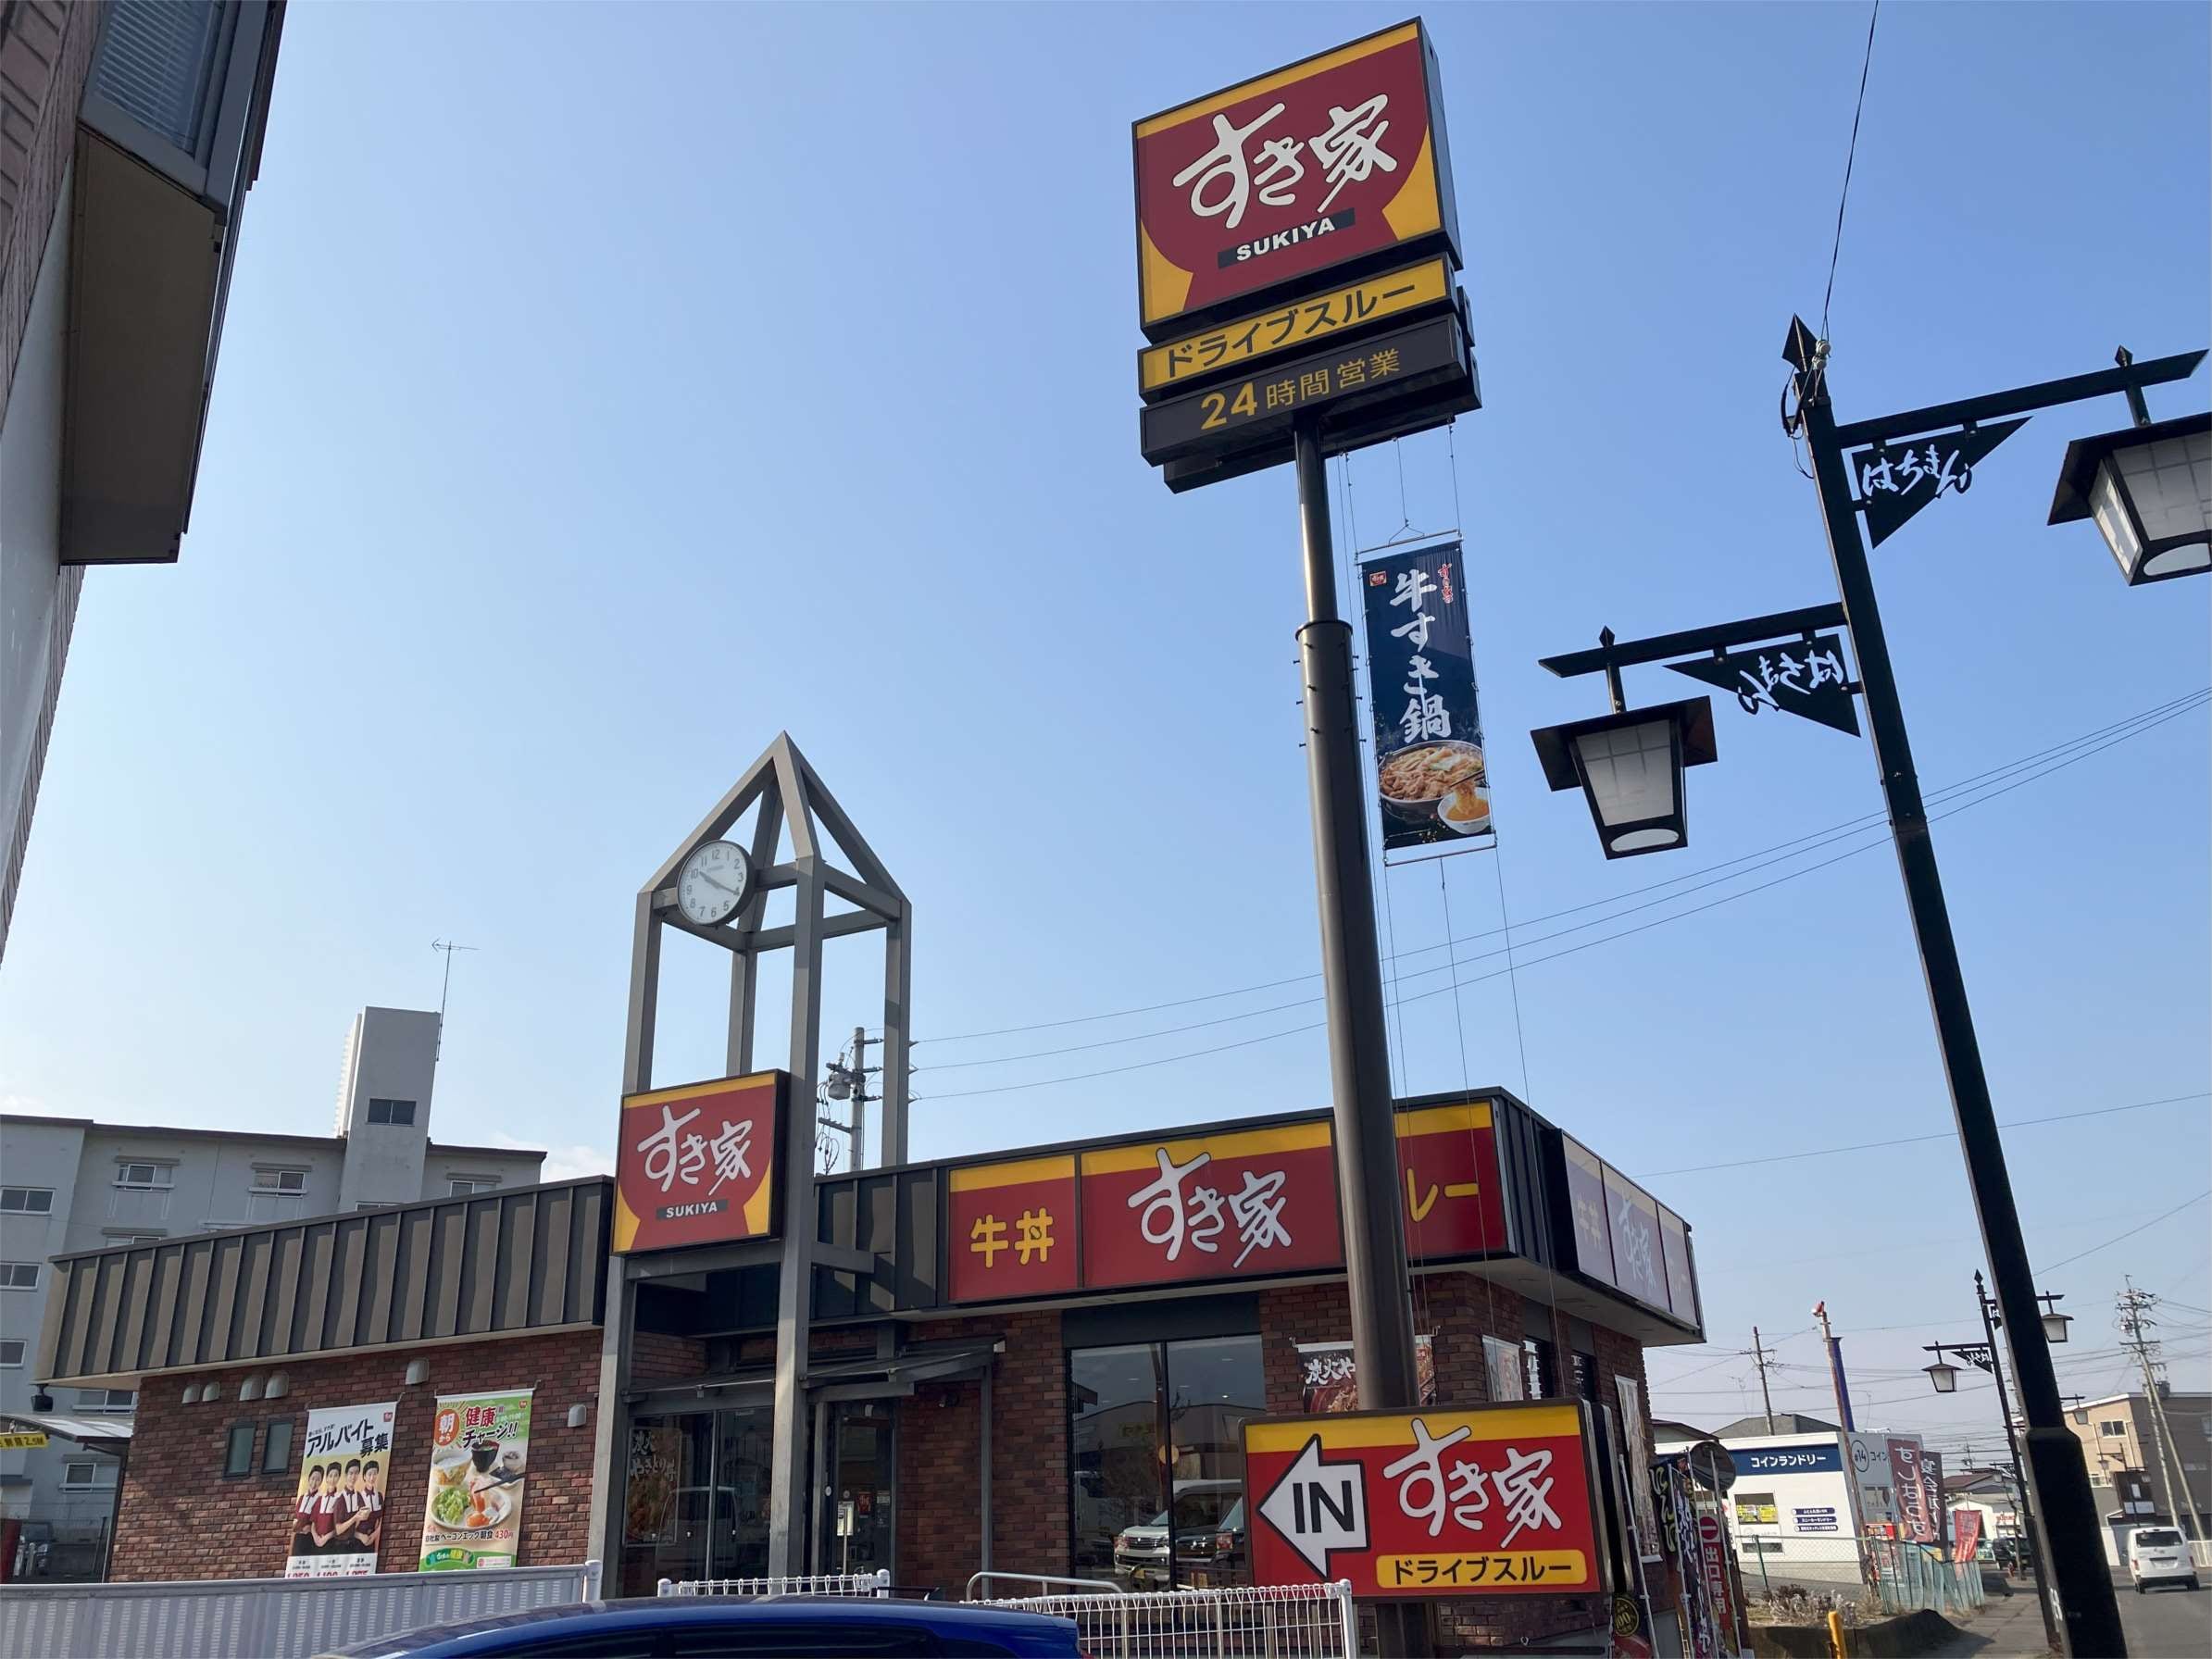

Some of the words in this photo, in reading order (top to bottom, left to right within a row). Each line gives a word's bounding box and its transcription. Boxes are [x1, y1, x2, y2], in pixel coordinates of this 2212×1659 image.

[1172, 94, 1397, 229] すき家
[1236, 217, 1335, 261] SUKIYA
[1168, 283, 1415, 378] ドライブスルー
[1200, 348, 1401, 430] 24時間営業
[1390, 568, 1452, 743] 牛すき鍋
[637, 1104, 753, 1195] すき家
[666, 1202, 718, 1218] SUKIYA
[1128, 1147, 1292, 1268] すき家
[1406, 1167, 1479, 1222] レー
[970, 1207, 1054, 1267] 牛丼
[306, 1418, 374, 1458] アルバイト
[466, 1406, 496, 1427] 健康
[360, 1432, 389, 1458] 募集
[1751, 1453, 1827, 1468] コインランドリー
[1293, 1480, 1355, 1533] IN
[1383, 1417, 1562, 1549] すき家
[1394, 1556, 1572, 1584] ドライブスルー
